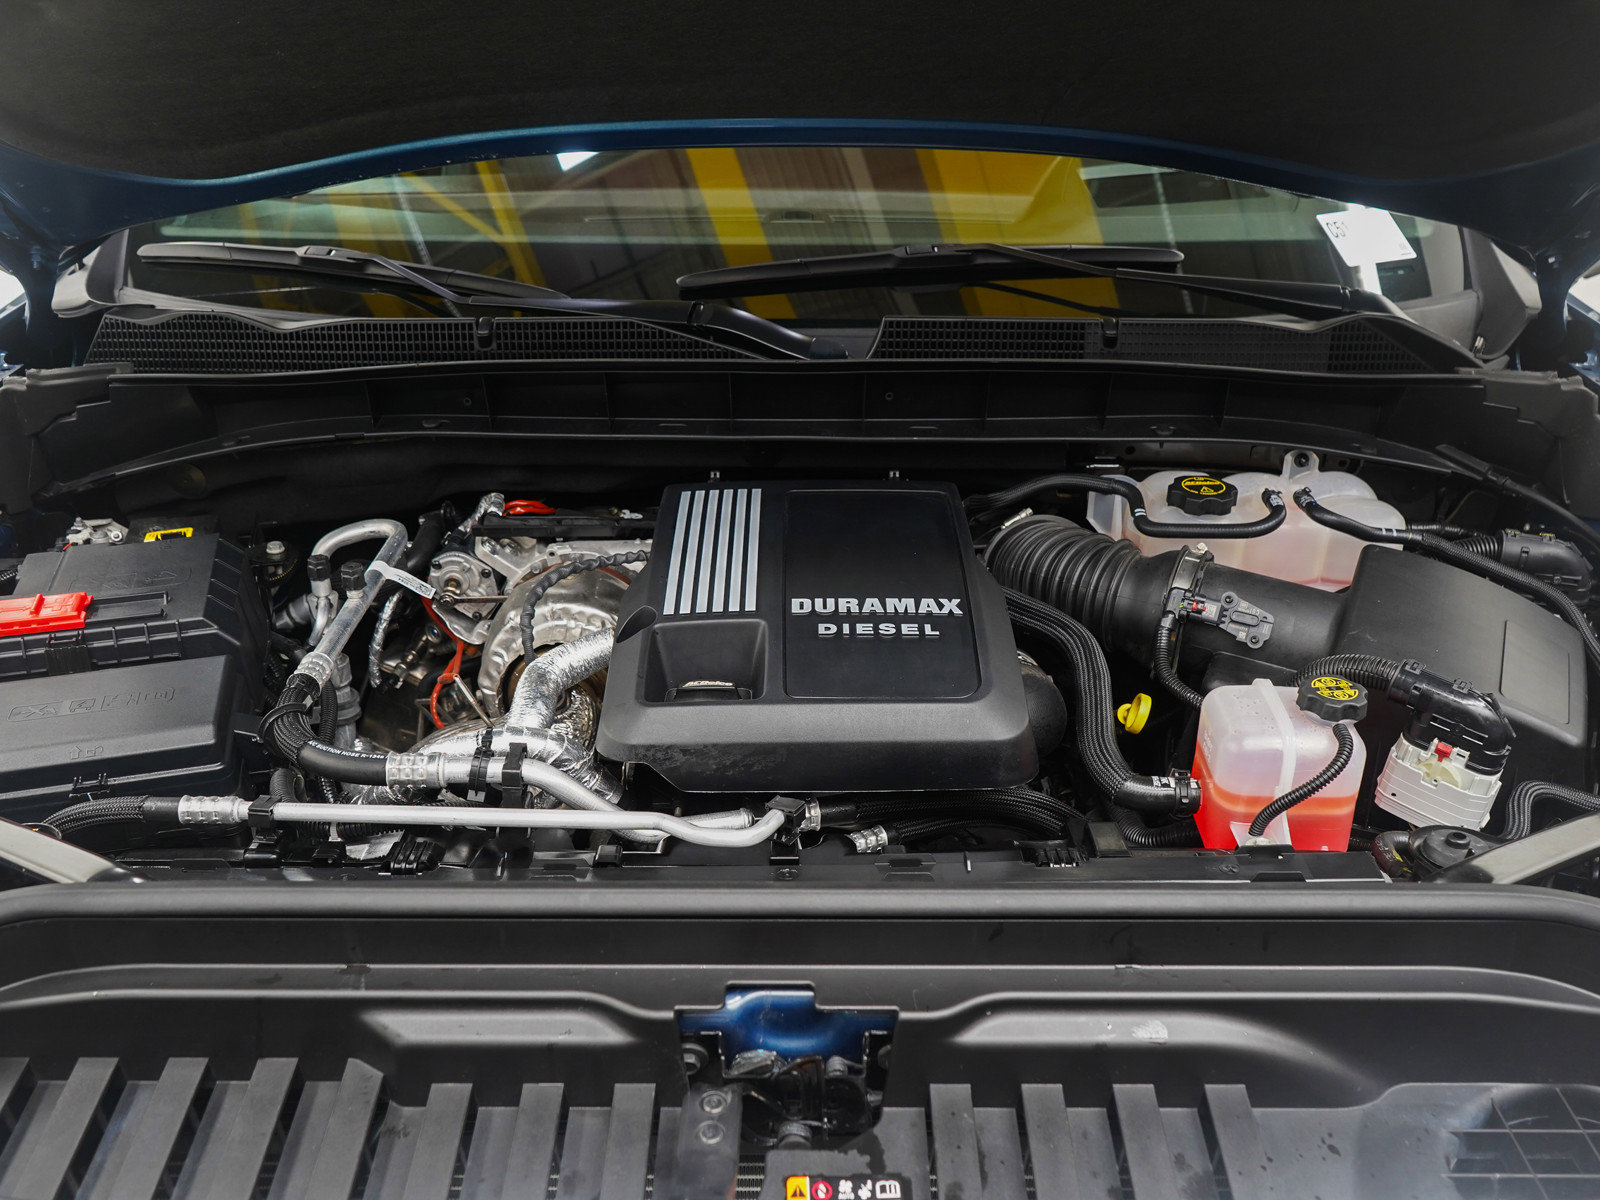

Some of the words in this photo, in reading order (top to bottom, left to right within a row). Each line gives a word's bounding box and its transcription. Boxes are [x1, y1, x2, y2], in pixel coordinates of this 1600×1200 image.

[791, 597, 963, 616] DURAMAX
[818, 623, 940, 637] DIESEL
[316, 743, 342, 755] SUCTION
